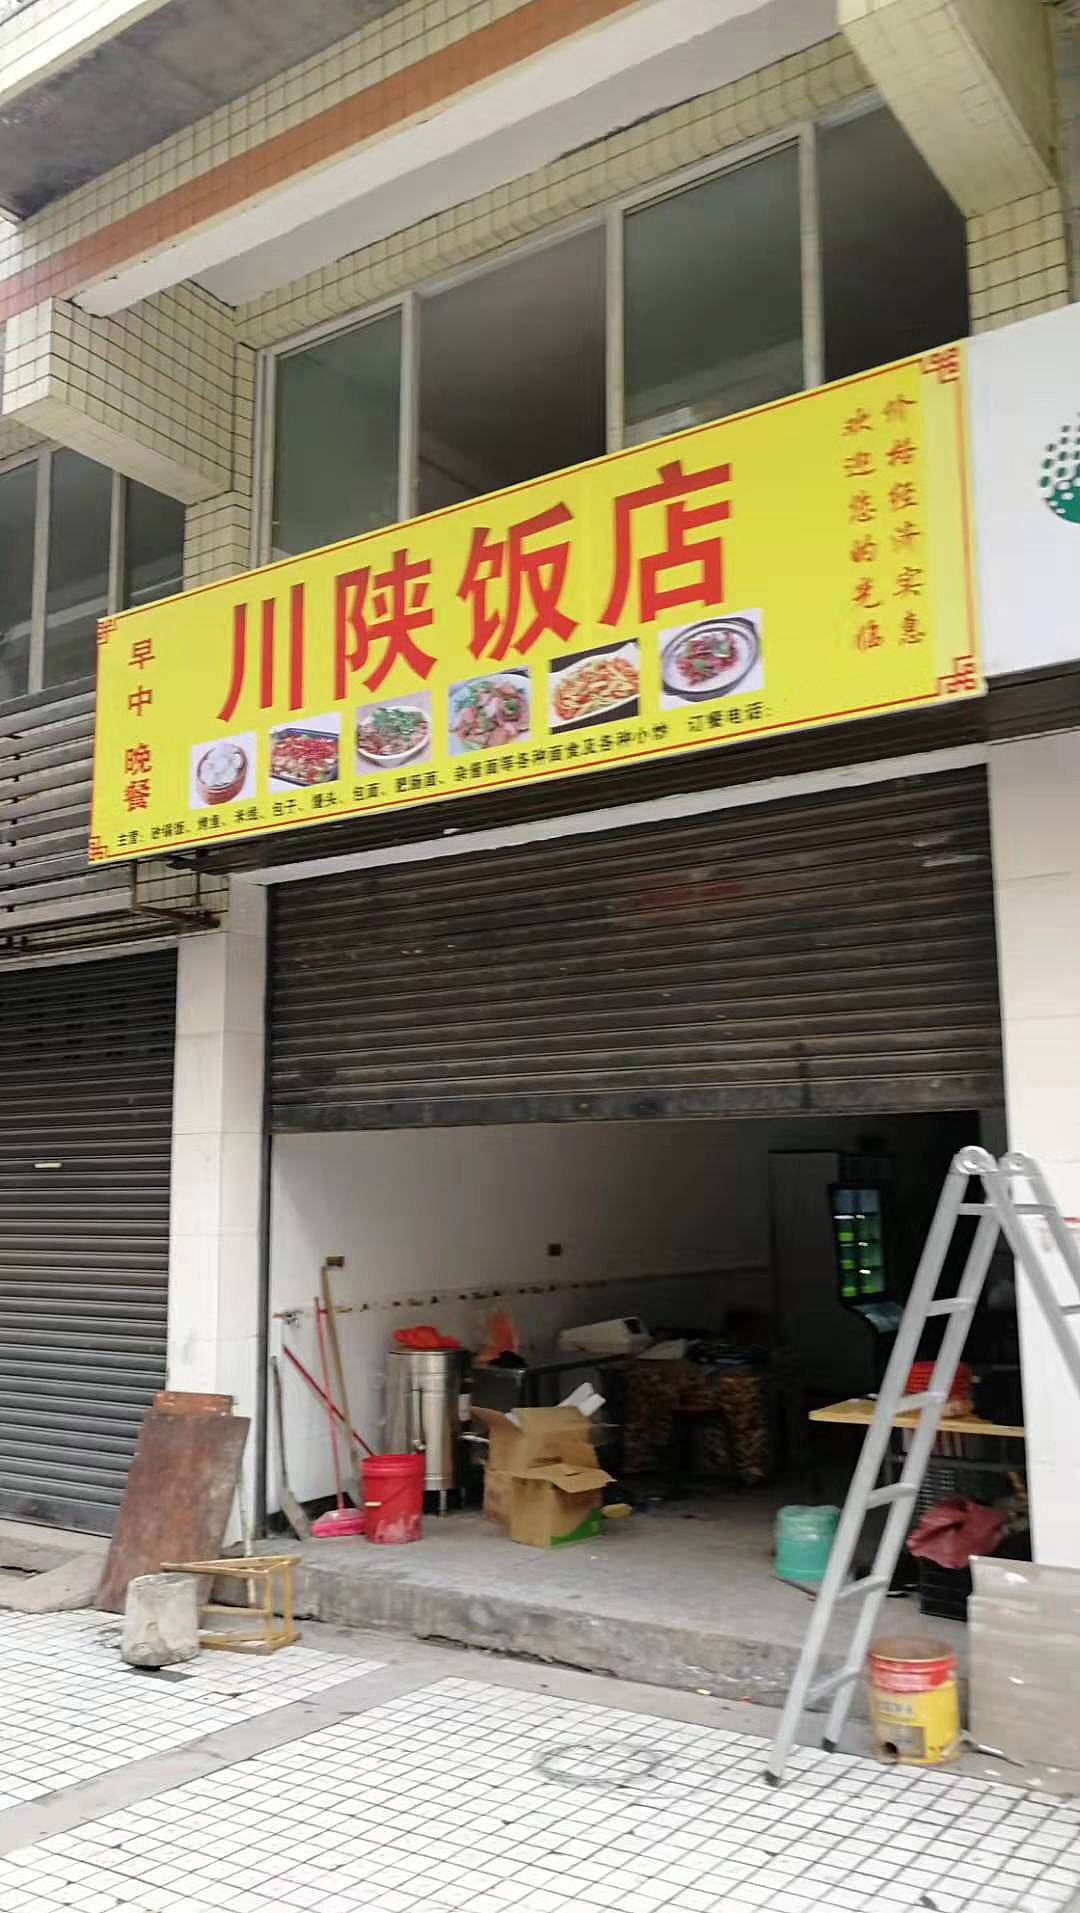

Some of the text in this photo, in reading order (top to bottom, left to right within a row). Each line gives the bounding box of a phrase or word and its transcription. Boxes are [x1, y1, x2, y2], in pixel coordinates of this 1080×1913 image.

[217, 460, 732, 722] 川陕饭店
[841, 407, 884, 652] 欢迎您的光临
[123, 638, 156, 812] 早中晚餐
